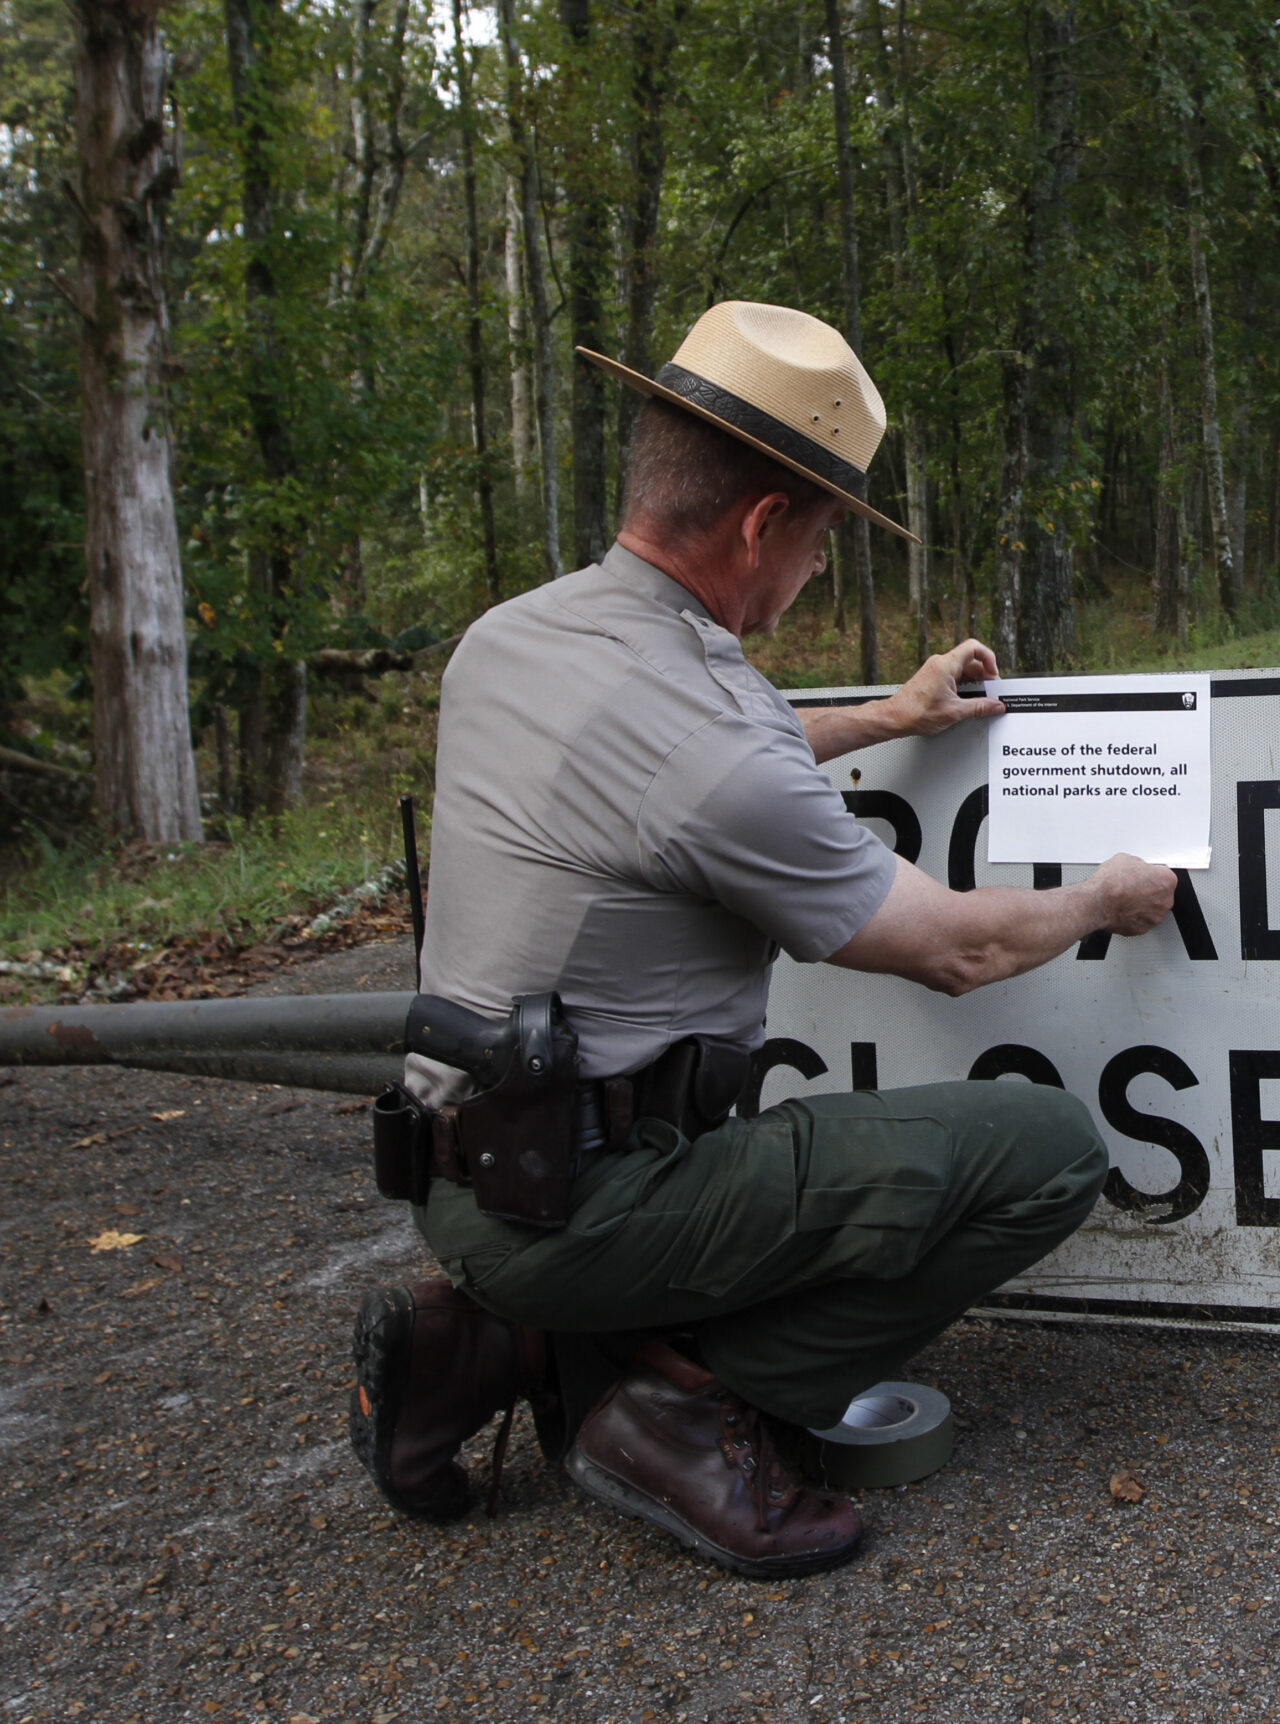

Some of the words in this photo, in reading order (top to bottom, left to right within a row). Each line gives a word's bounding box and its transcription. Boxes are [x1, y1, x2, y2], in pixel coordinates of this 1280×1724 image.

[1002, 745, 1057, 757] Because
[1060, 743, 1076, 756] of
[1079, 743, 1103, 756] the
[1106, 743, 1157, 756] federal
[1002, 765, 1087, 779] government
[1090, 763, 1165, 777] shutdown,
[1170, 763, 1188, 776] all
[1002, 784, 1059, 797] national
[1063, 784, 1101, 799] parks
[1104, 787, 1128, 796] are
[1131, 783, 1182, 796] closed.
